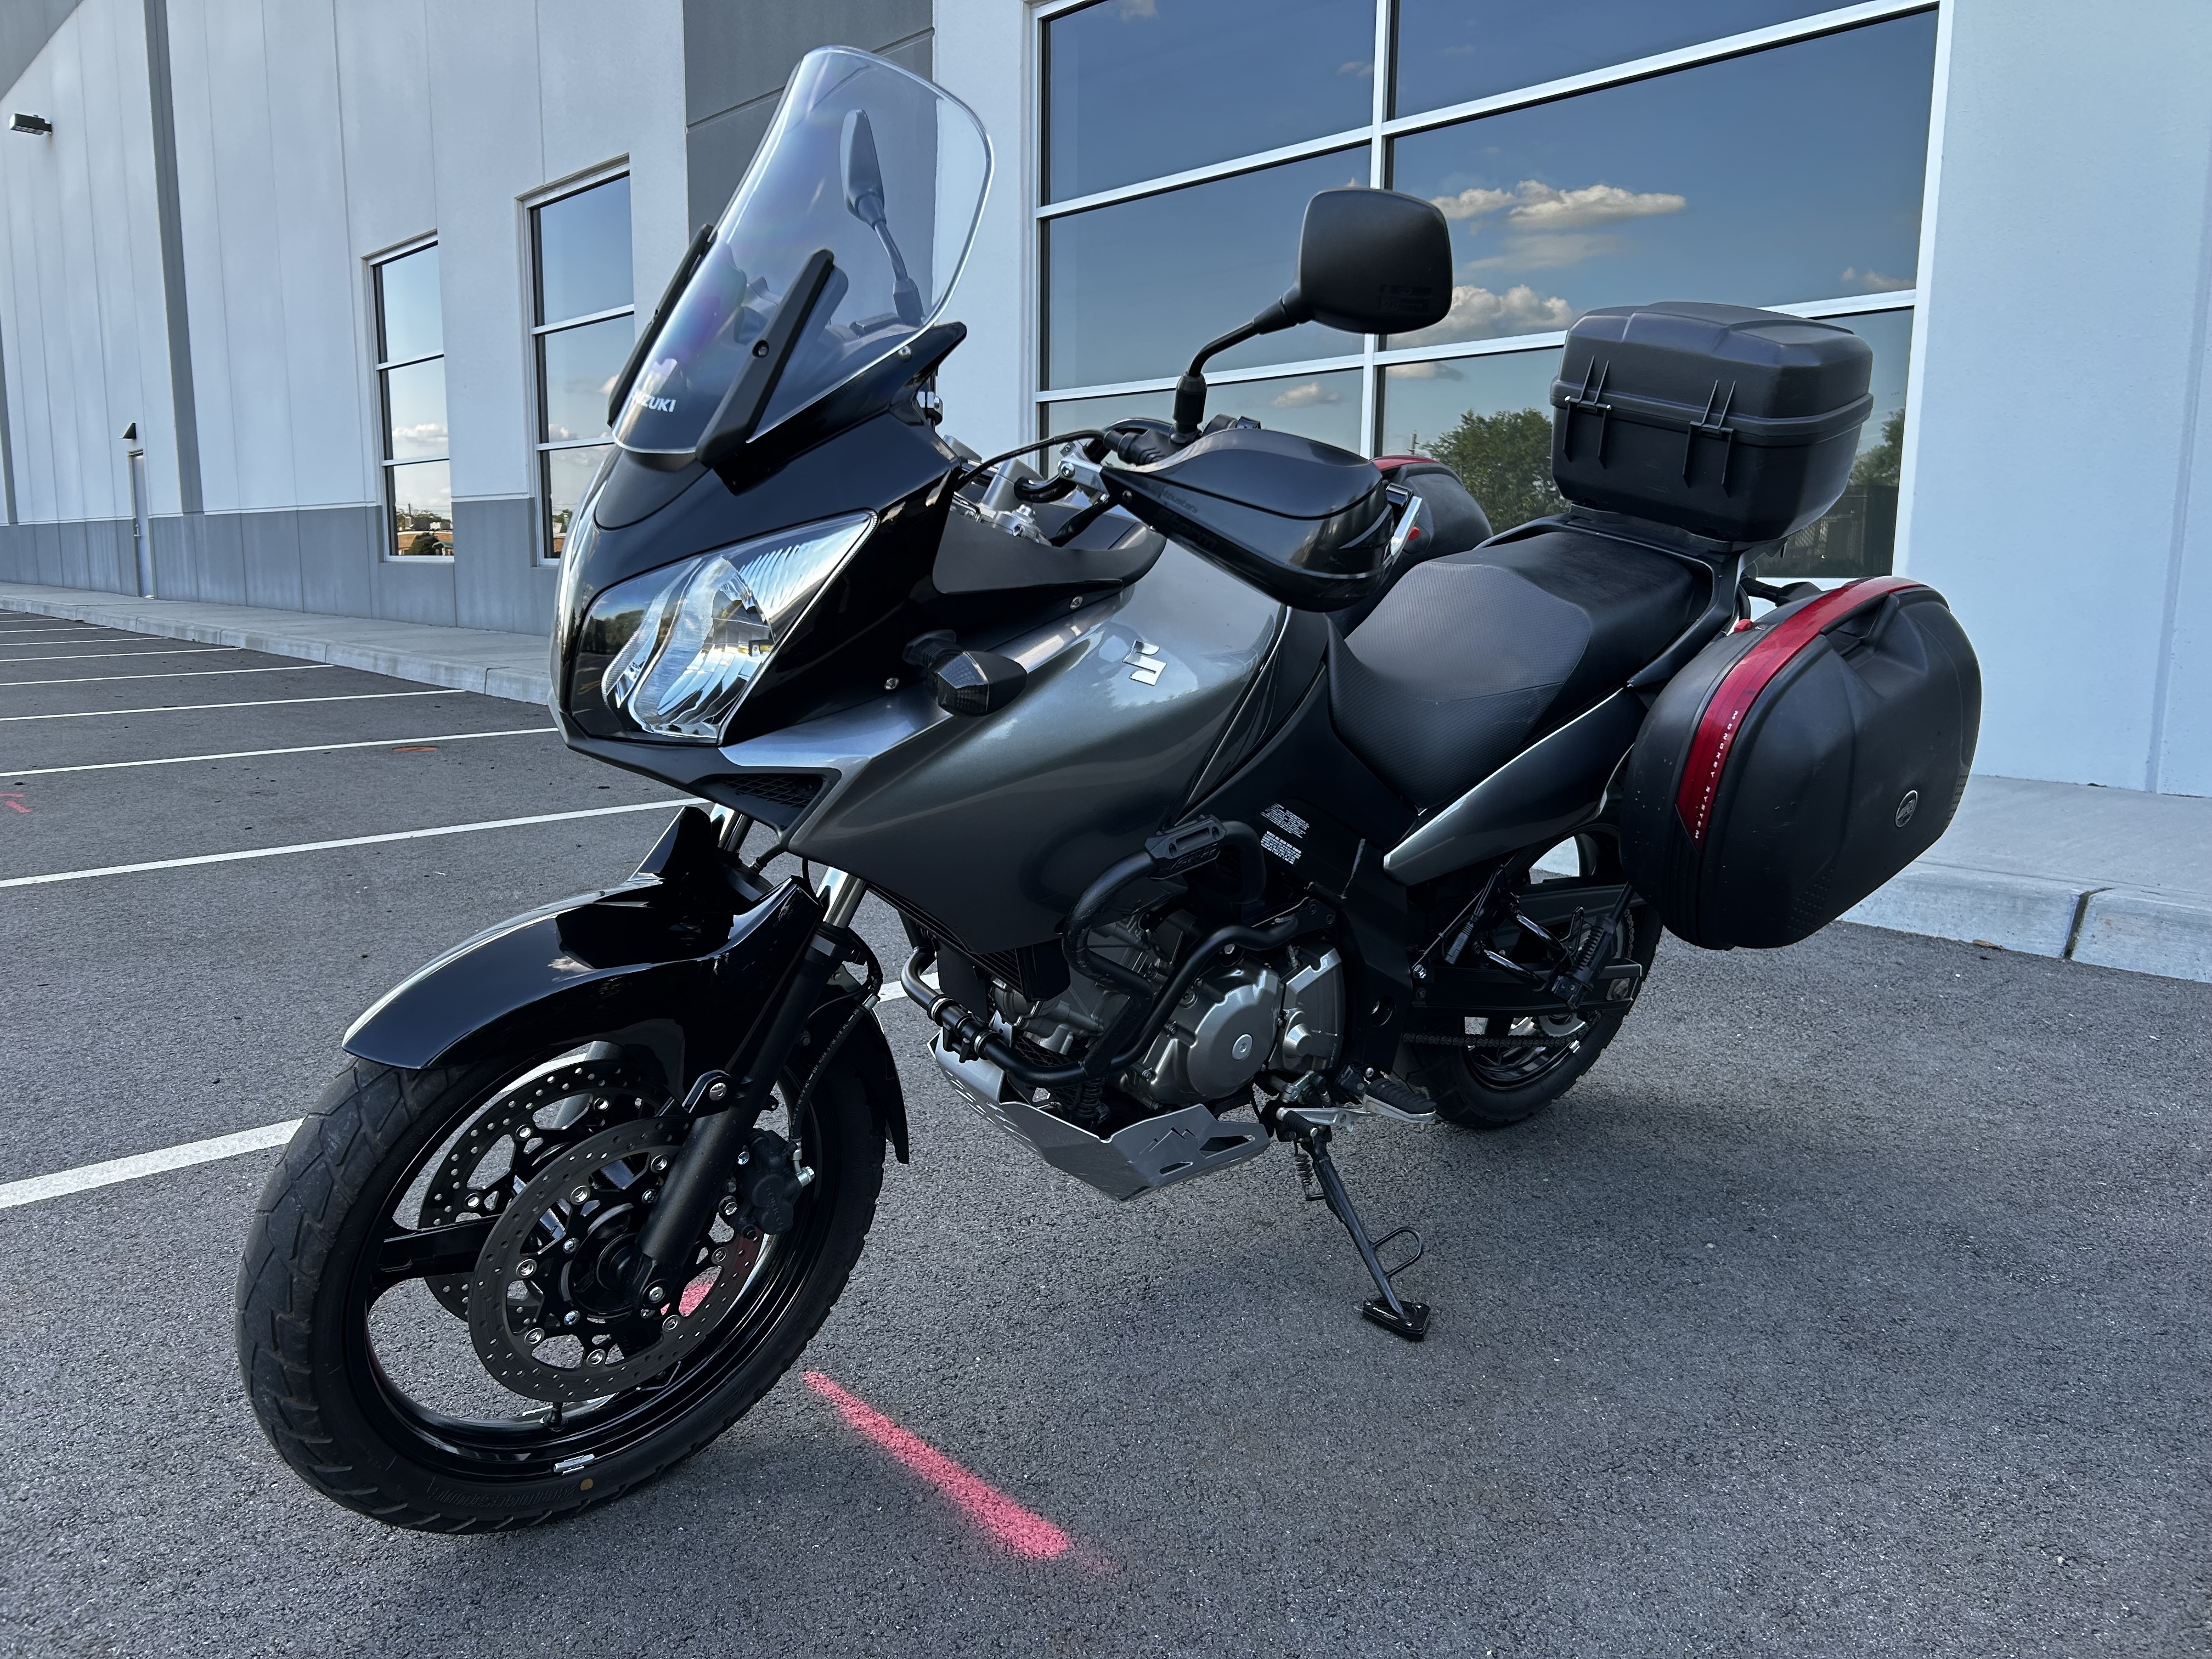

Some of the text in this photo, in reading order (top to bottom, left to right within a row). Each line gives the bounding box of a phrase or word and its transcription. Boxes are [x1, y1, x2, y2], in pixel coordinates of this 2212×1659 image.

[1695, 710, 1739, 839] MONOKEY SYSTEM
[765, 1187, 786, 1226] TOKICO
[427, 1484, 577, 1508] BRIDGESTONE
